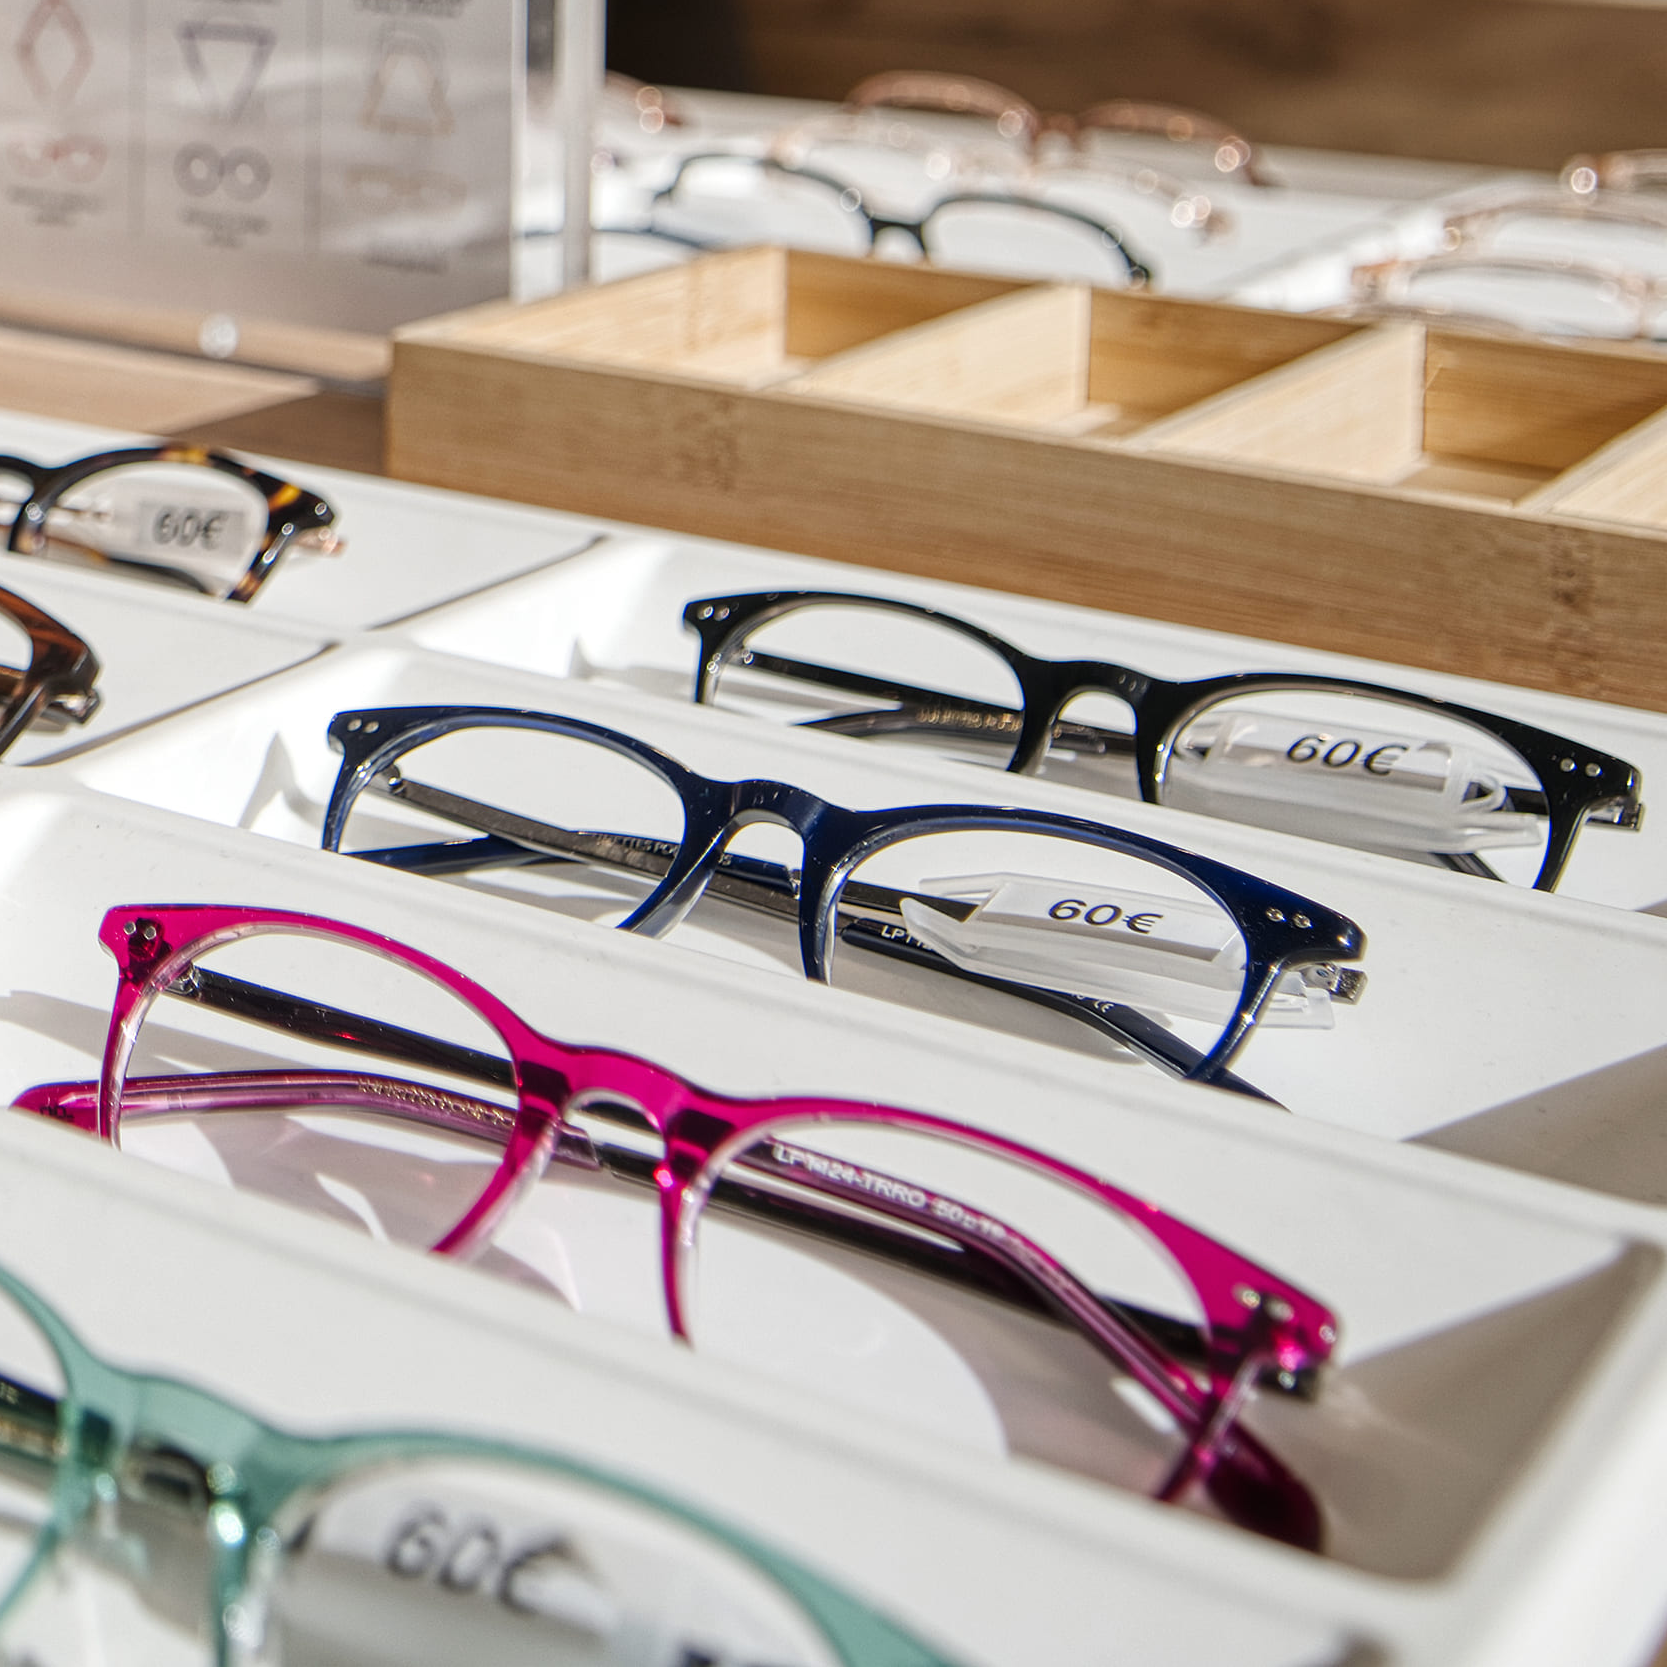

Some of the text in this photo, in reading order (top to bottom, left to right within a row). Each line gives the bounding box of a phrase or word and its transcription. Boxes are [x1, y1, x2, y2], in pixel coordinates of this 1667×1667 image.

[152, 505, 228, 550] 60€
[1286, 733, 1409, 775] 60€
[1048, 899, 1163, 934] 60€
